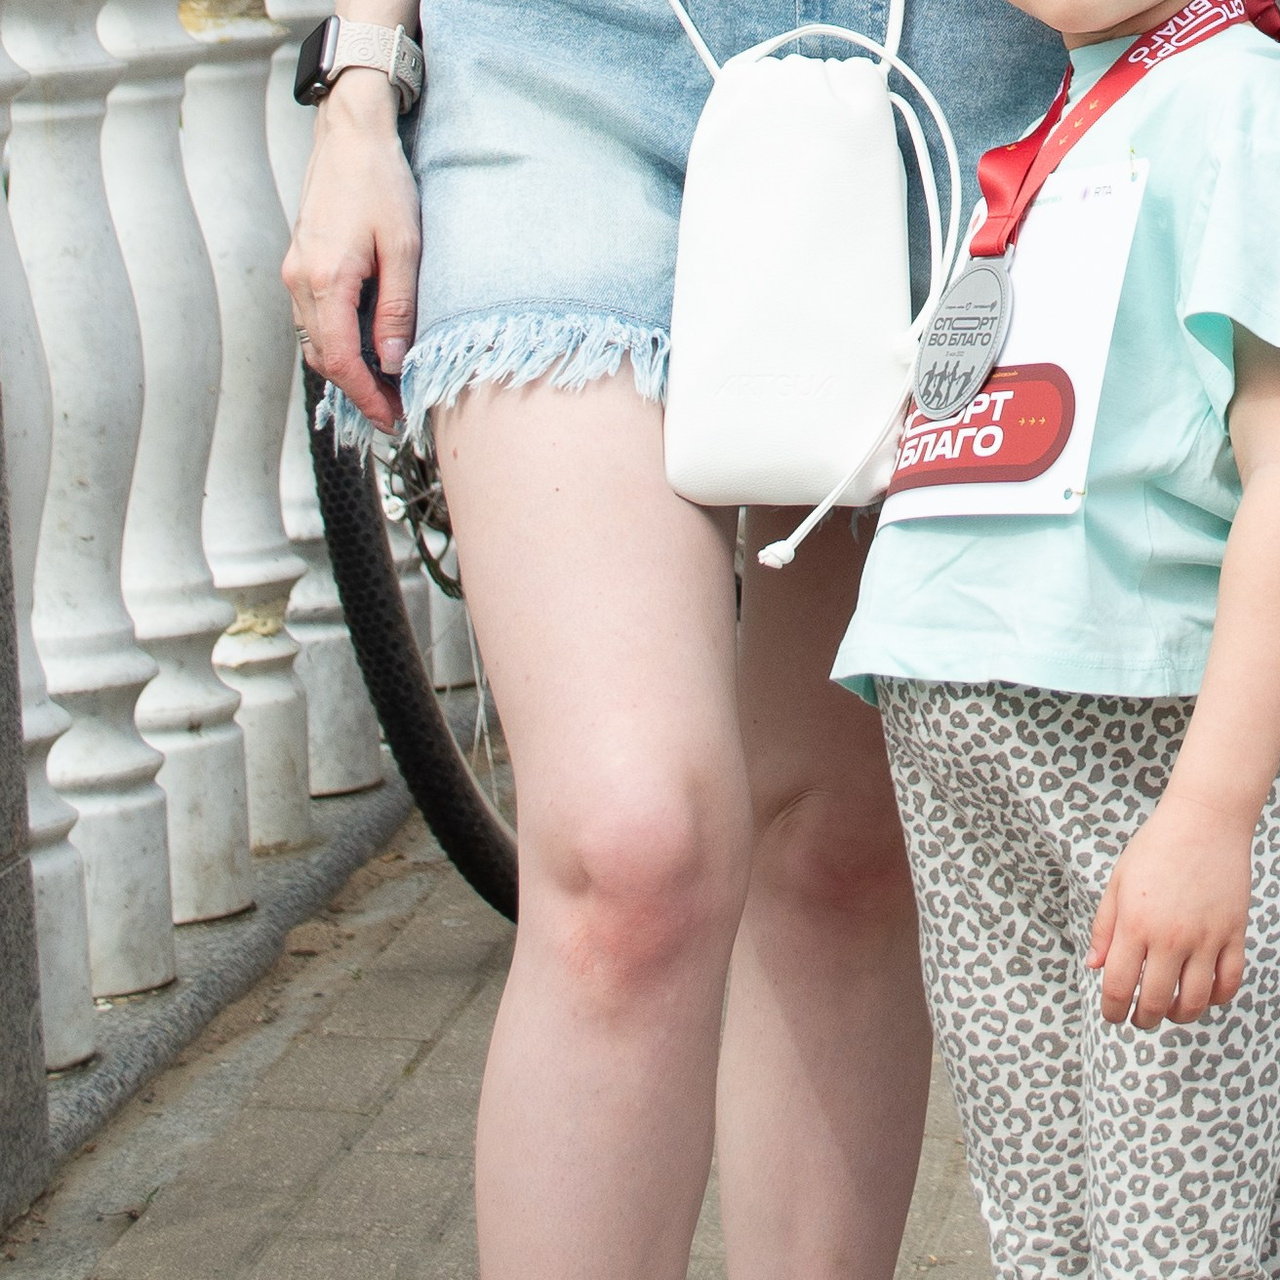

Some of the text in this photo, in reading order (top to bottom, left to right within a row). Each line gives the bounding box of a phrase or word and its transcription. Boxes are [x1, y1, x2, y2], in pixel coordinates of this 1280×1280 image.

[934, 316, 998, 331] СПОРТ
[928, 332, 993, 347] ВО БЛАГО
[898, 425, 1004, 471] БЛАГО
